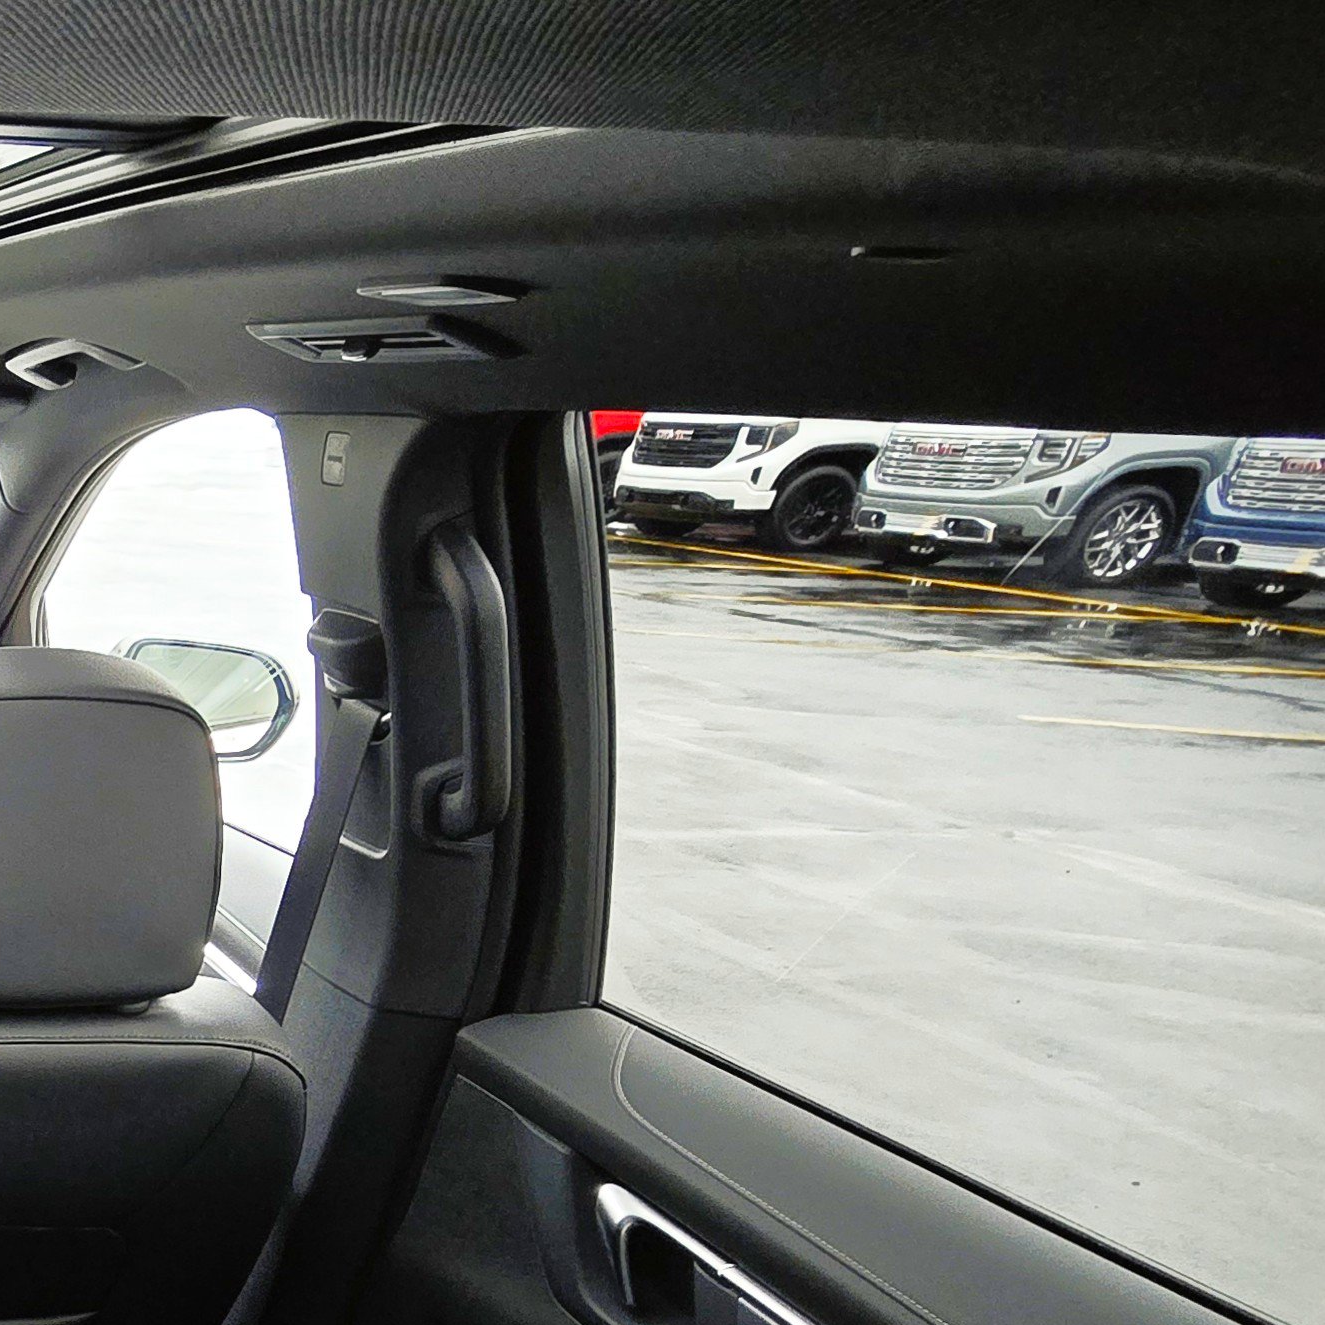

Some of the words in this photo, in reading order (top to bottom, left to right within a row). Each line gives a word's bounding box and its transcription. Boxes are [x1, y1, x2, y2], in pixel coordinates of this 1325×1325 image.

[655, 428, 694, 441] GMC
[915, 443, 967, 457] GMC
[1286, 458, 1325, 474] GM
